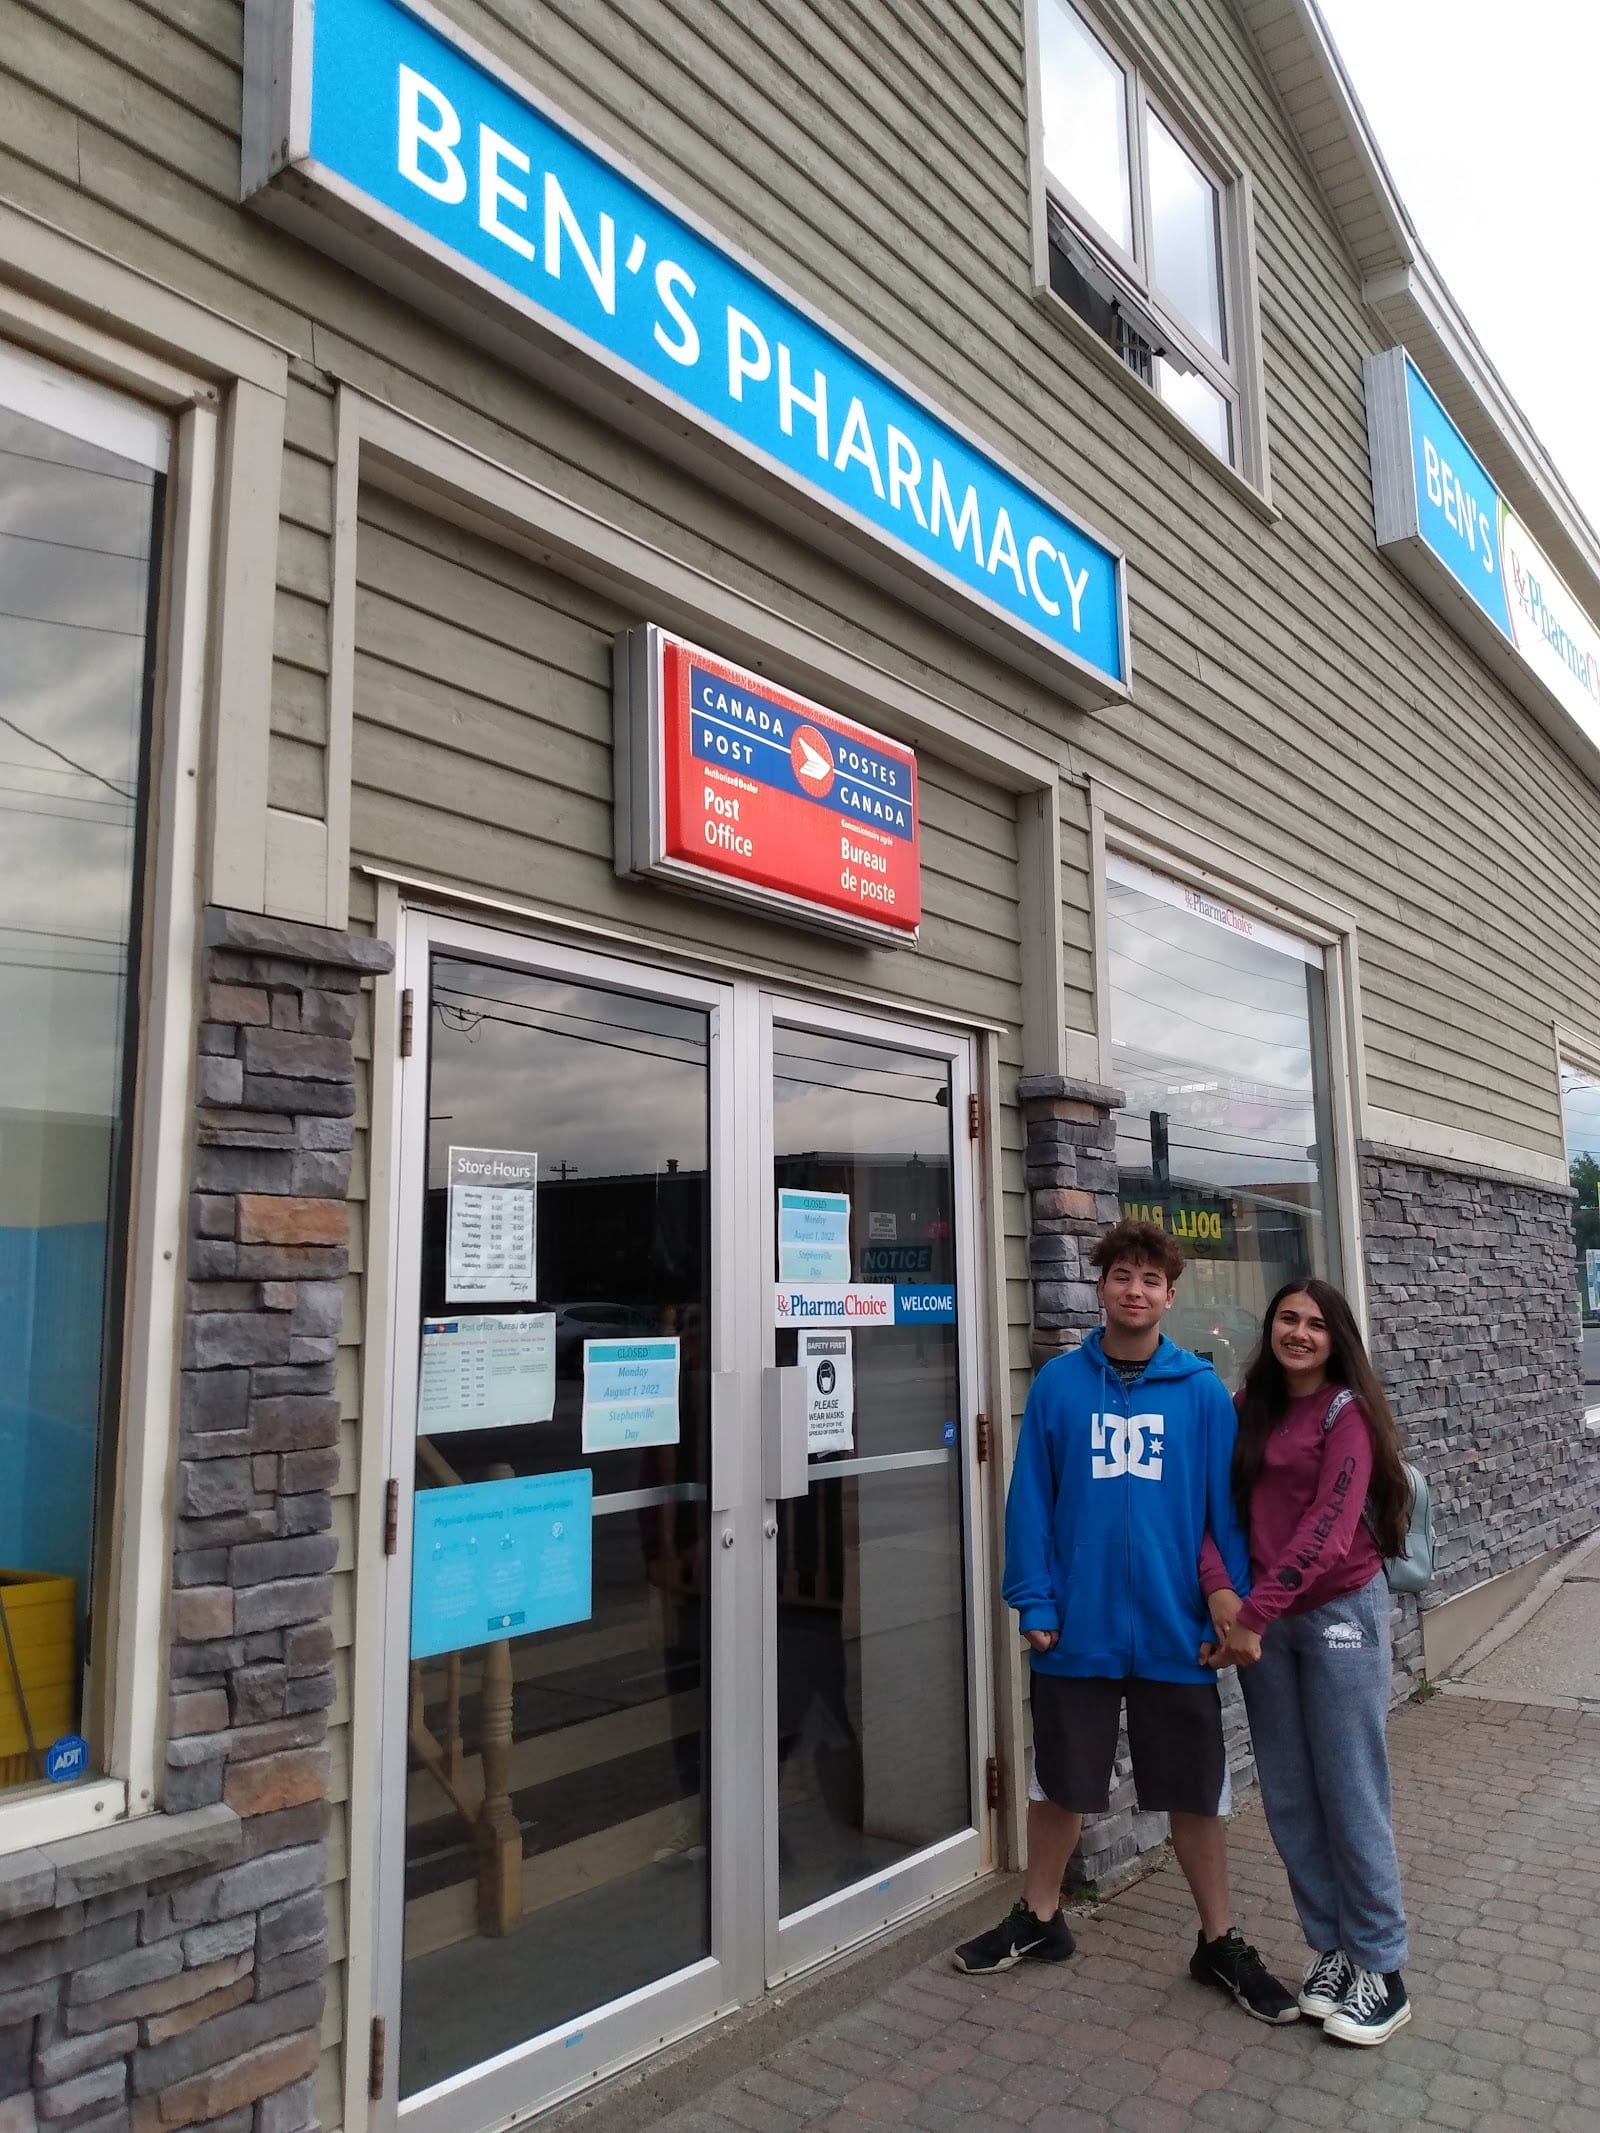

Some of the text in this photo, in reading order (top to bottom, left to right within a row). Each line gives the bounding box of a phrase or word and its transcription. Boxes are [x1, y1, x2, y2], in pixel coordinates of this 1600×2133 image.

[398, 62, 1090, 633] BEN'S PHARMACY
[1423, 434, 1494, 574] BEN'S
[703, 687, 784, 738] CANADA
[703, 729, 753, 765] POST
[839, 747, 897, 787] POSTES
[704, 765, 759, 795] Authorized Dealer
[703, 786, 740, 822] Post
[840, 787, 905, 828] CANADA
[704, 819, 753, 857] Office
[841, 837, 887, 874] Bureau
[841, 867, 896, 906] de poste
[1192, 892, 1253, 936] PharmaChoice
[457, 1157, 531, 1178] Store Hours
[803, 1199, 827, 1209] CLOSED
[863, 1249, 929, 1269] NOTICE
[790, 1294, 953, 1316] PharmaChoice WELCOME
[617, 1347, 648, 1359] CLOSED
[807, 1341, 846, 1350] SAFETY FIRST
[617, 1367, 649, 1379] Monday
[603, 1384, 660, 1400] August 1, 2022
[608, 1407, 656, 1424] Stephenville
[808, 1410, 845, 1421] WEAR MASKS
[814, 1399, 840, 1410] PLEASE
[624, 1428, 640, 1441] Day
[1327, 1639, 1362, 1649] Roots
[53, 1747, 82, 1772] ADT
